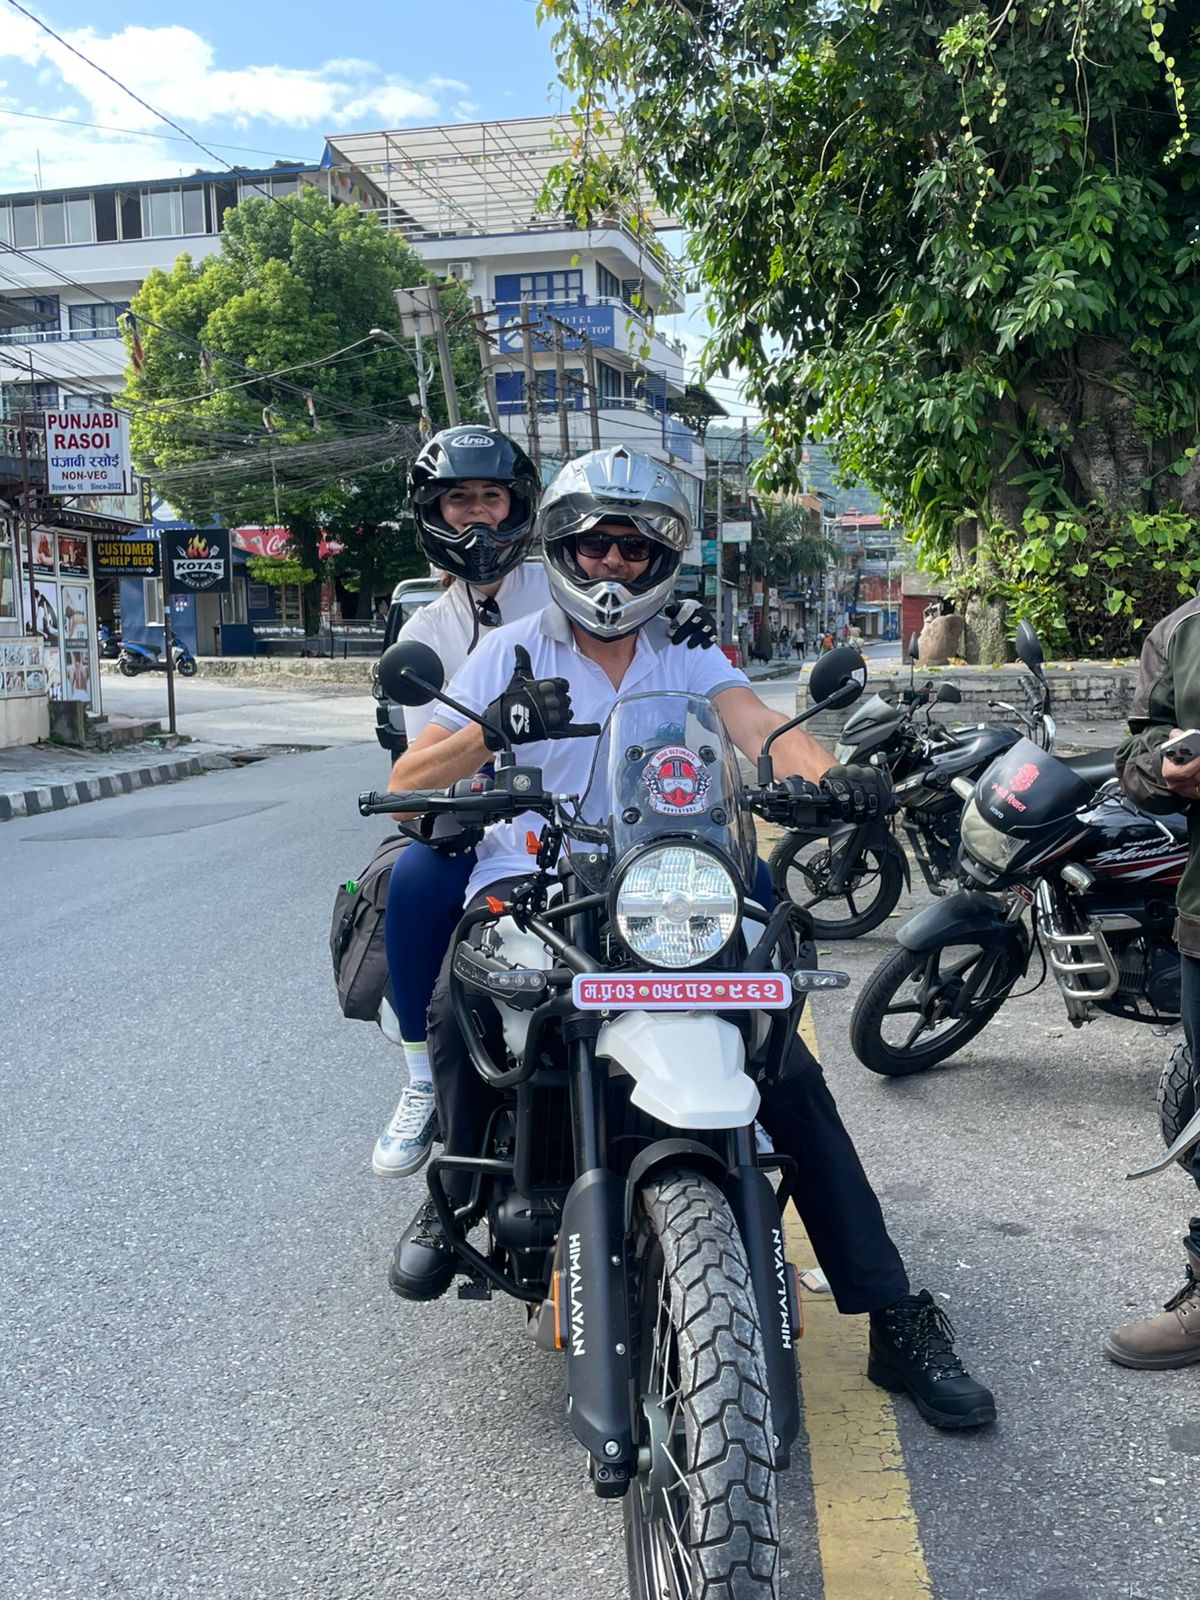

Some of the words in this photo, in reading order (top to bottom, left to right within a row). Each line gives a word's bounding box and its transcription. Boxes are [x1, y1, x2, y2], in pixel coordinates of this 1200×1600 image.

[591, 326, 611, 335] TOP
[48, 413, 119, 429] PUNJABI
[54, 433, 110, 449] RASOI
[89, 453, 120, 468] रसोई
[62, 471, 108, 480] NON-VEG
[142, 482, 151, 520] SPA
[97, 543, 154, 556] CUSTOMER
[110, 556, 131, 566] HELP
[133, 556, 154, 566] DESK
[176, 562, 222, 570] KOTAS
[656, 750, 668, 761] RIDE
[668, 748, 696, 761] ULTIMATE
[568, 1233, 585, 1356] HIMALAYAN
[772, 1228, 792, 1350] HIMALAYAN
